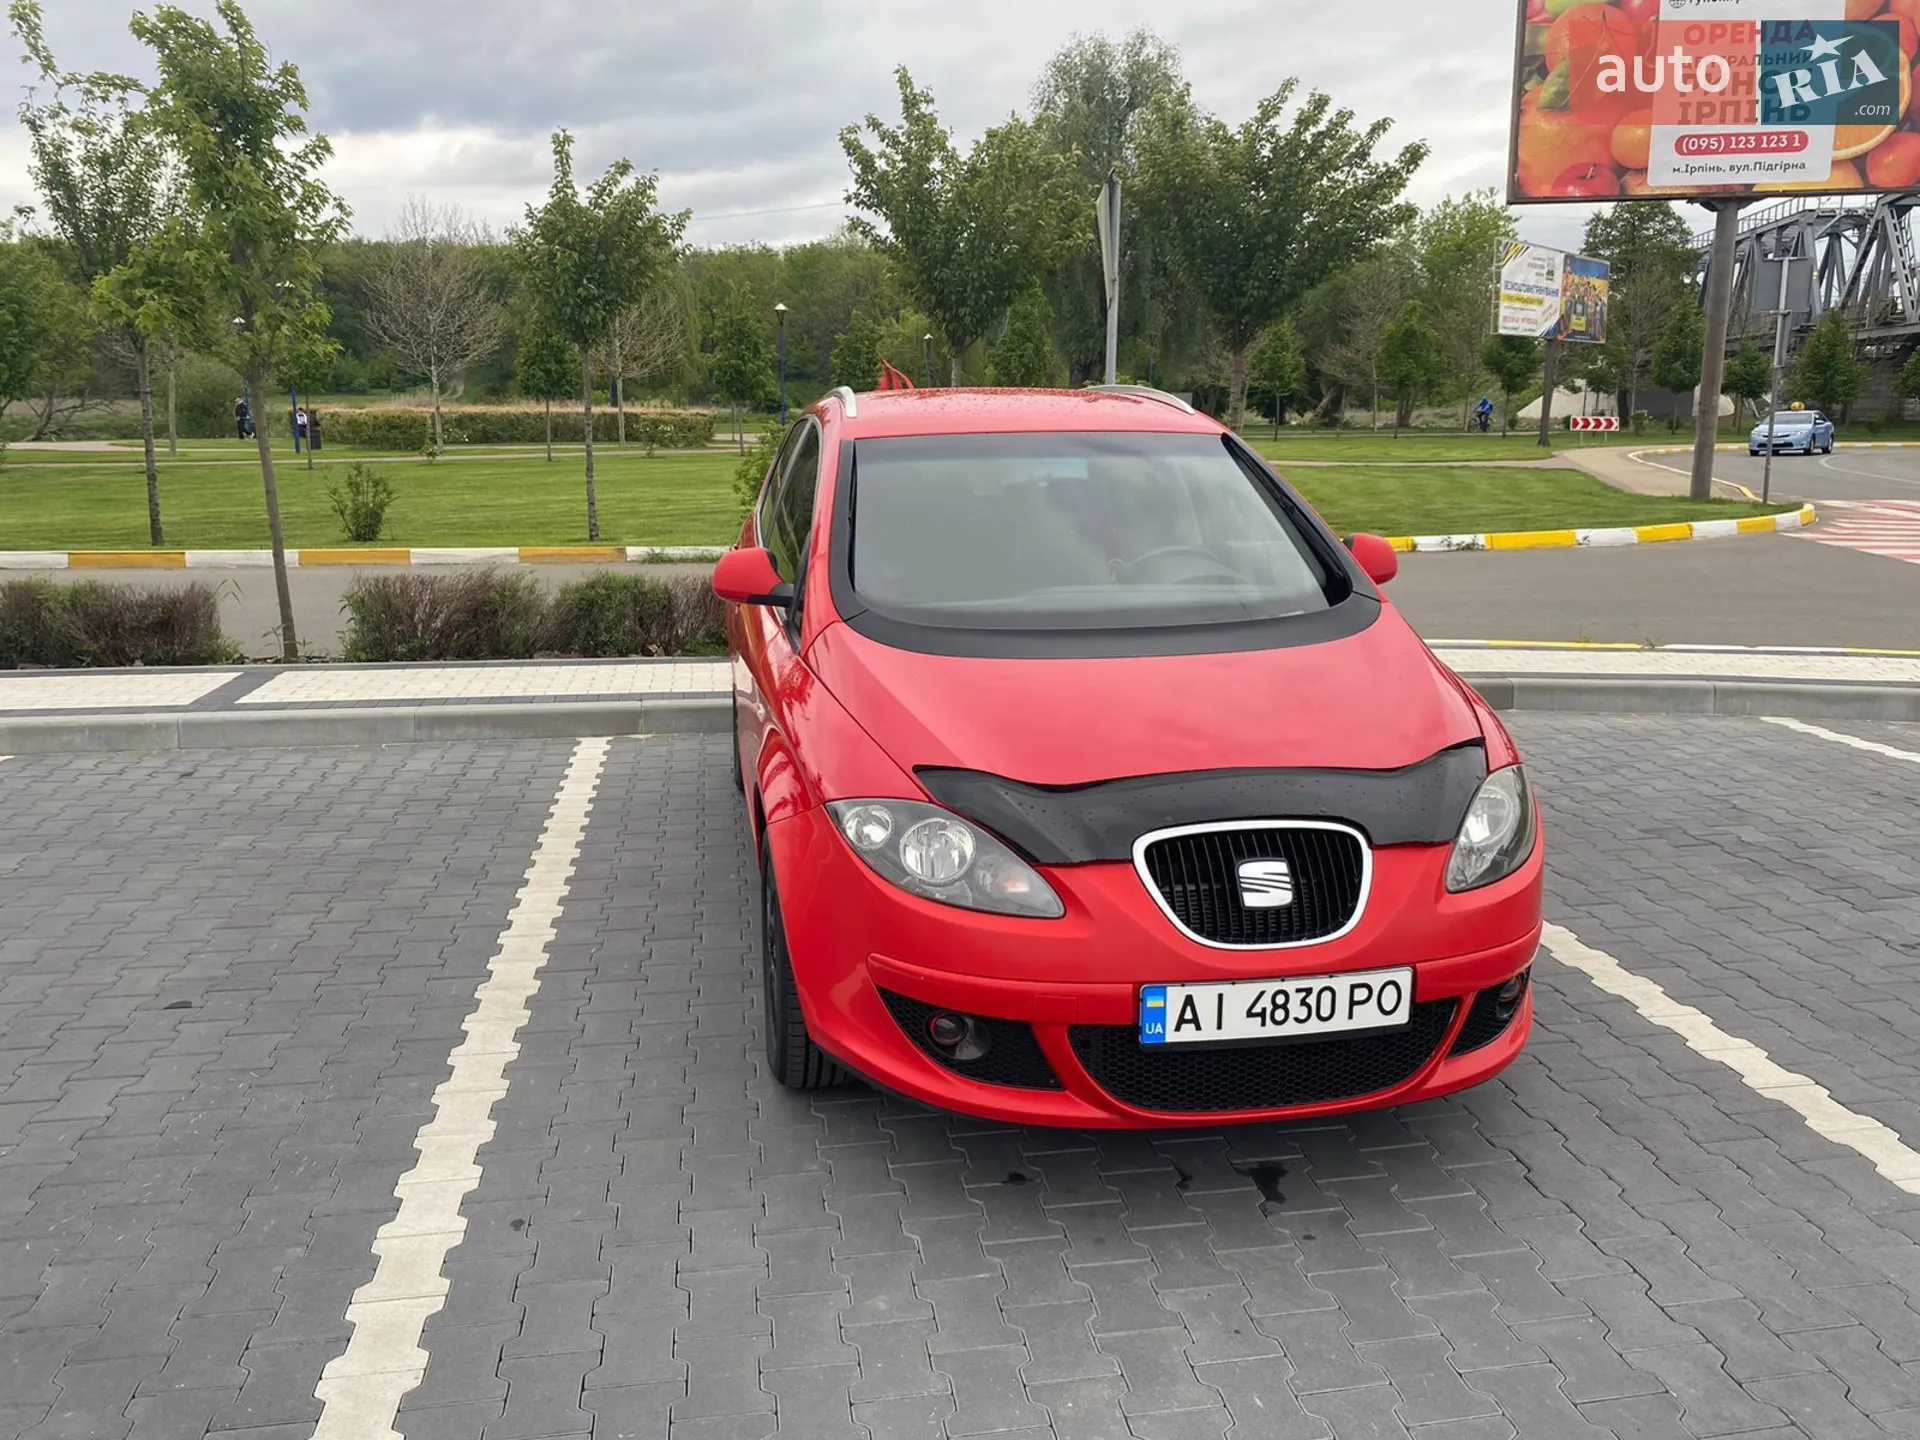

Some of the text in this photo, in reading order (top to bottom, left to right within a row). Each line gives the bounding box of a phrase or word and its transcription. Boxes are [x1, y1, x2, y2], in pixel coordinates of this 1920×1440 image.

[1684, 19, 1817, 46] ОРЕНДА
[1677, 98, 1811, 125] ІРПІНЬ
[1682, 134, 1800, 153] (095) 123 123 1
[1174, 994, 1223, 1032] AI
[1246, 985, 1336, 1027] 4830
[1145, 1020, 1163, 1034] UA
